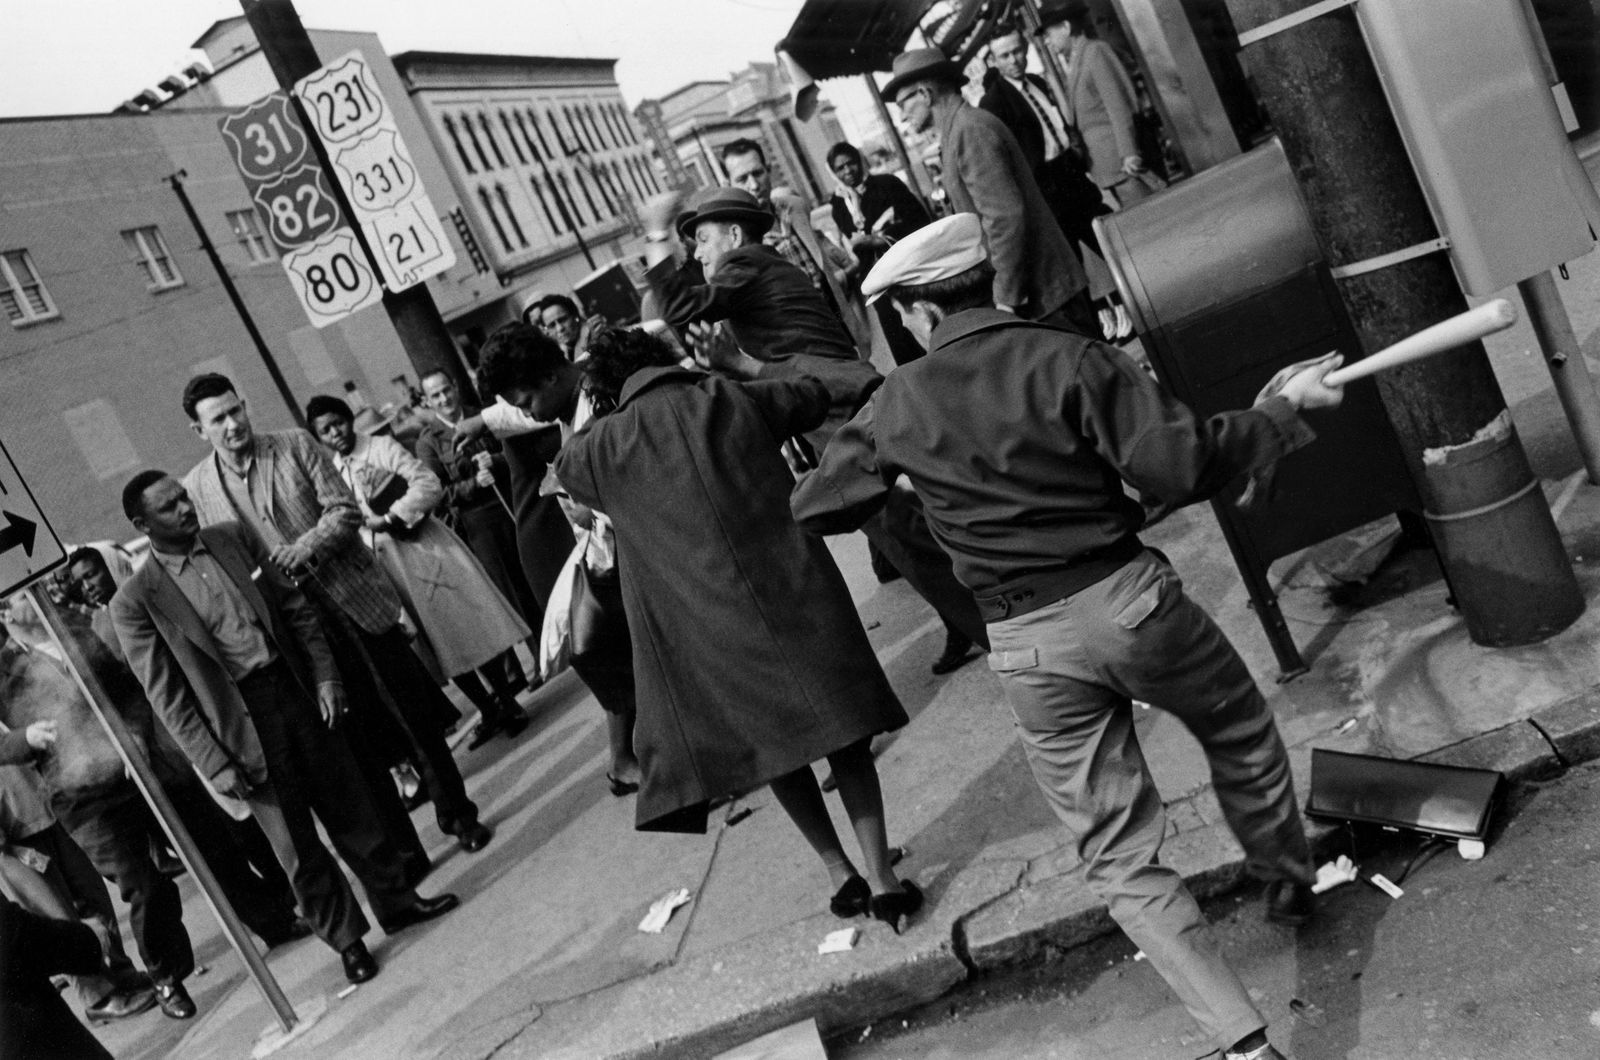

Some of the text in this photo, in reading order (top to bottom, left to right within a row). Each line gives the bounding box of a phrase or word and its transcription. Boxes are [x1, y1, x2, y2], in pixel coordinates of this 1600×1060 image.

[317, 74, 374, 133] 231
[244, 113, 293, 166] 31
[355, 157, 405, 201] 331
[271, 183, 331, 238] 82
[388, 225, 425, 264] 21
[306, 252, 360, 303] 80
